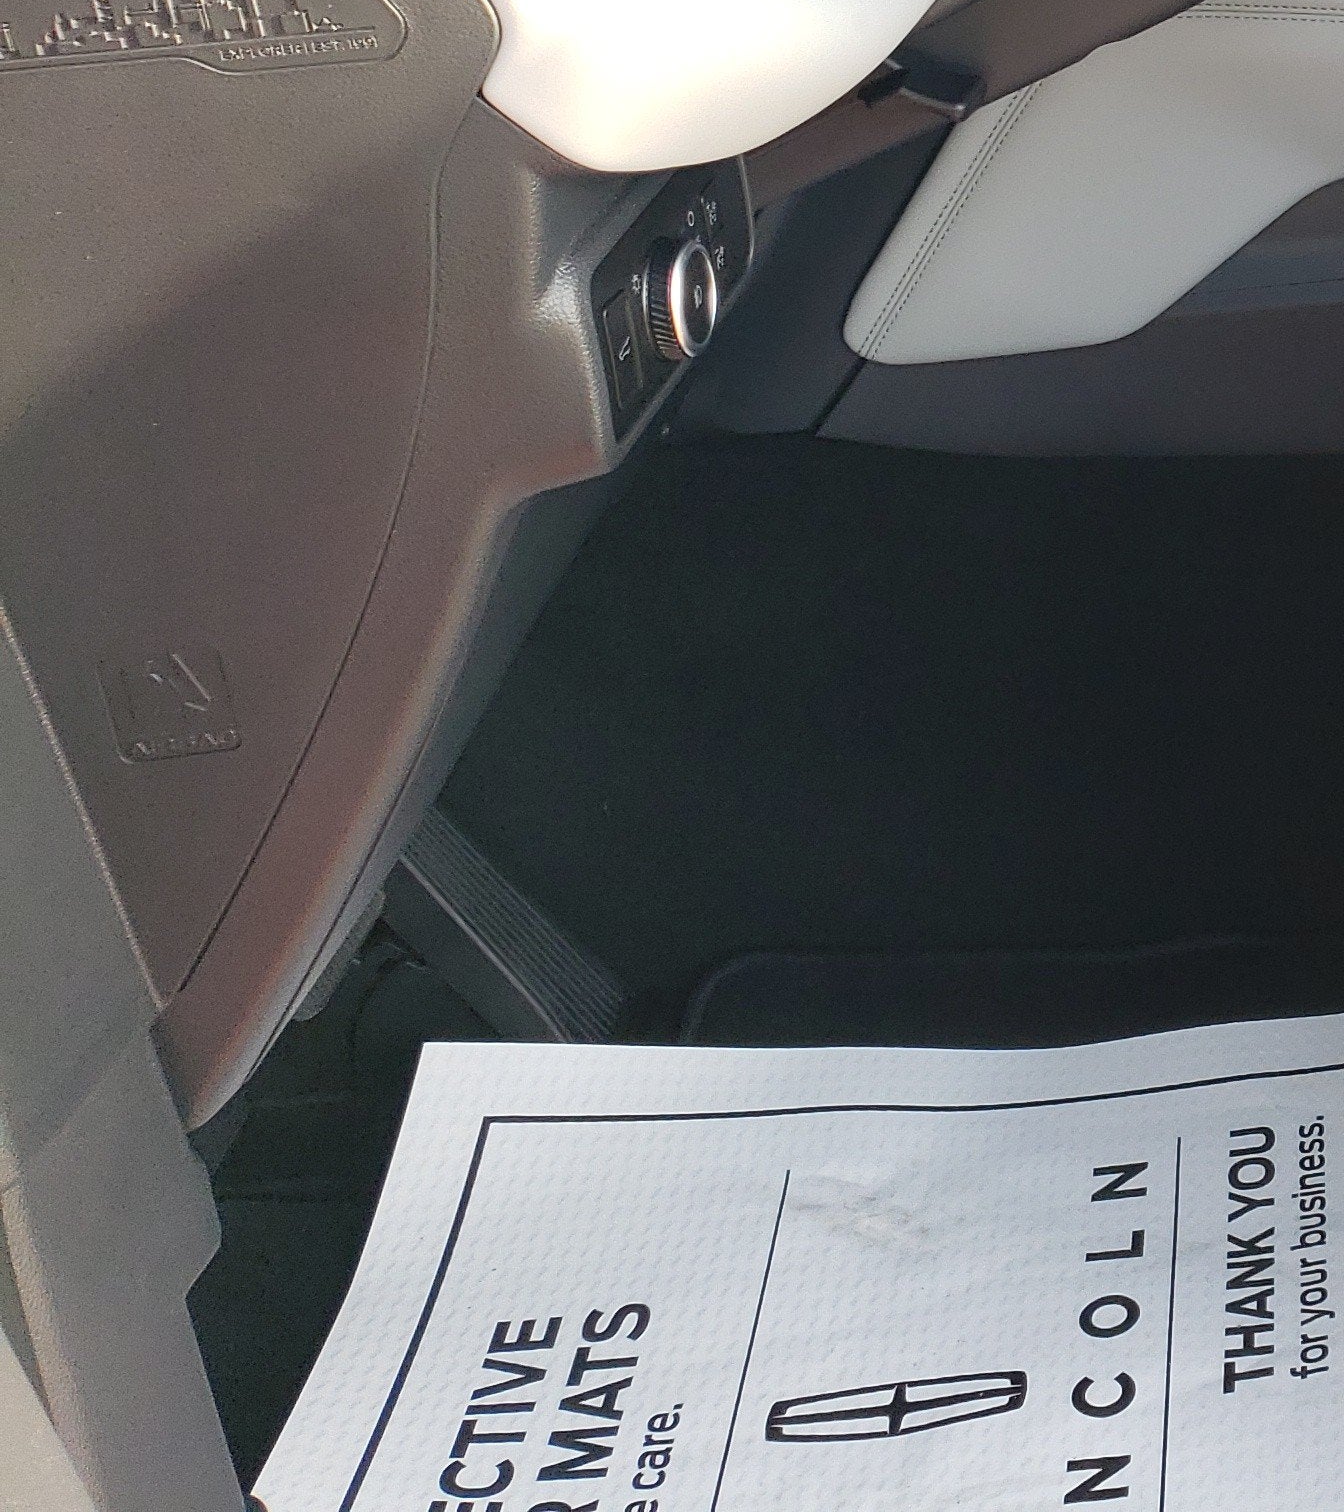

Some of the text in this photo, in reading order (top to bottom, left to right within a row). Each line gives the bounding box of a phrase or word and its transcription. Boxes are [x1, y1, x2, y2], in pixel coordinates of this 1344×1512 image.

[1223, 1126, 1276, 1394] THANK YOU
[1290, 1114, 1335, 1379] for your business.
[537, 1303, 651, 1481] MATS
[632, 1403, 684, 1490] care.
